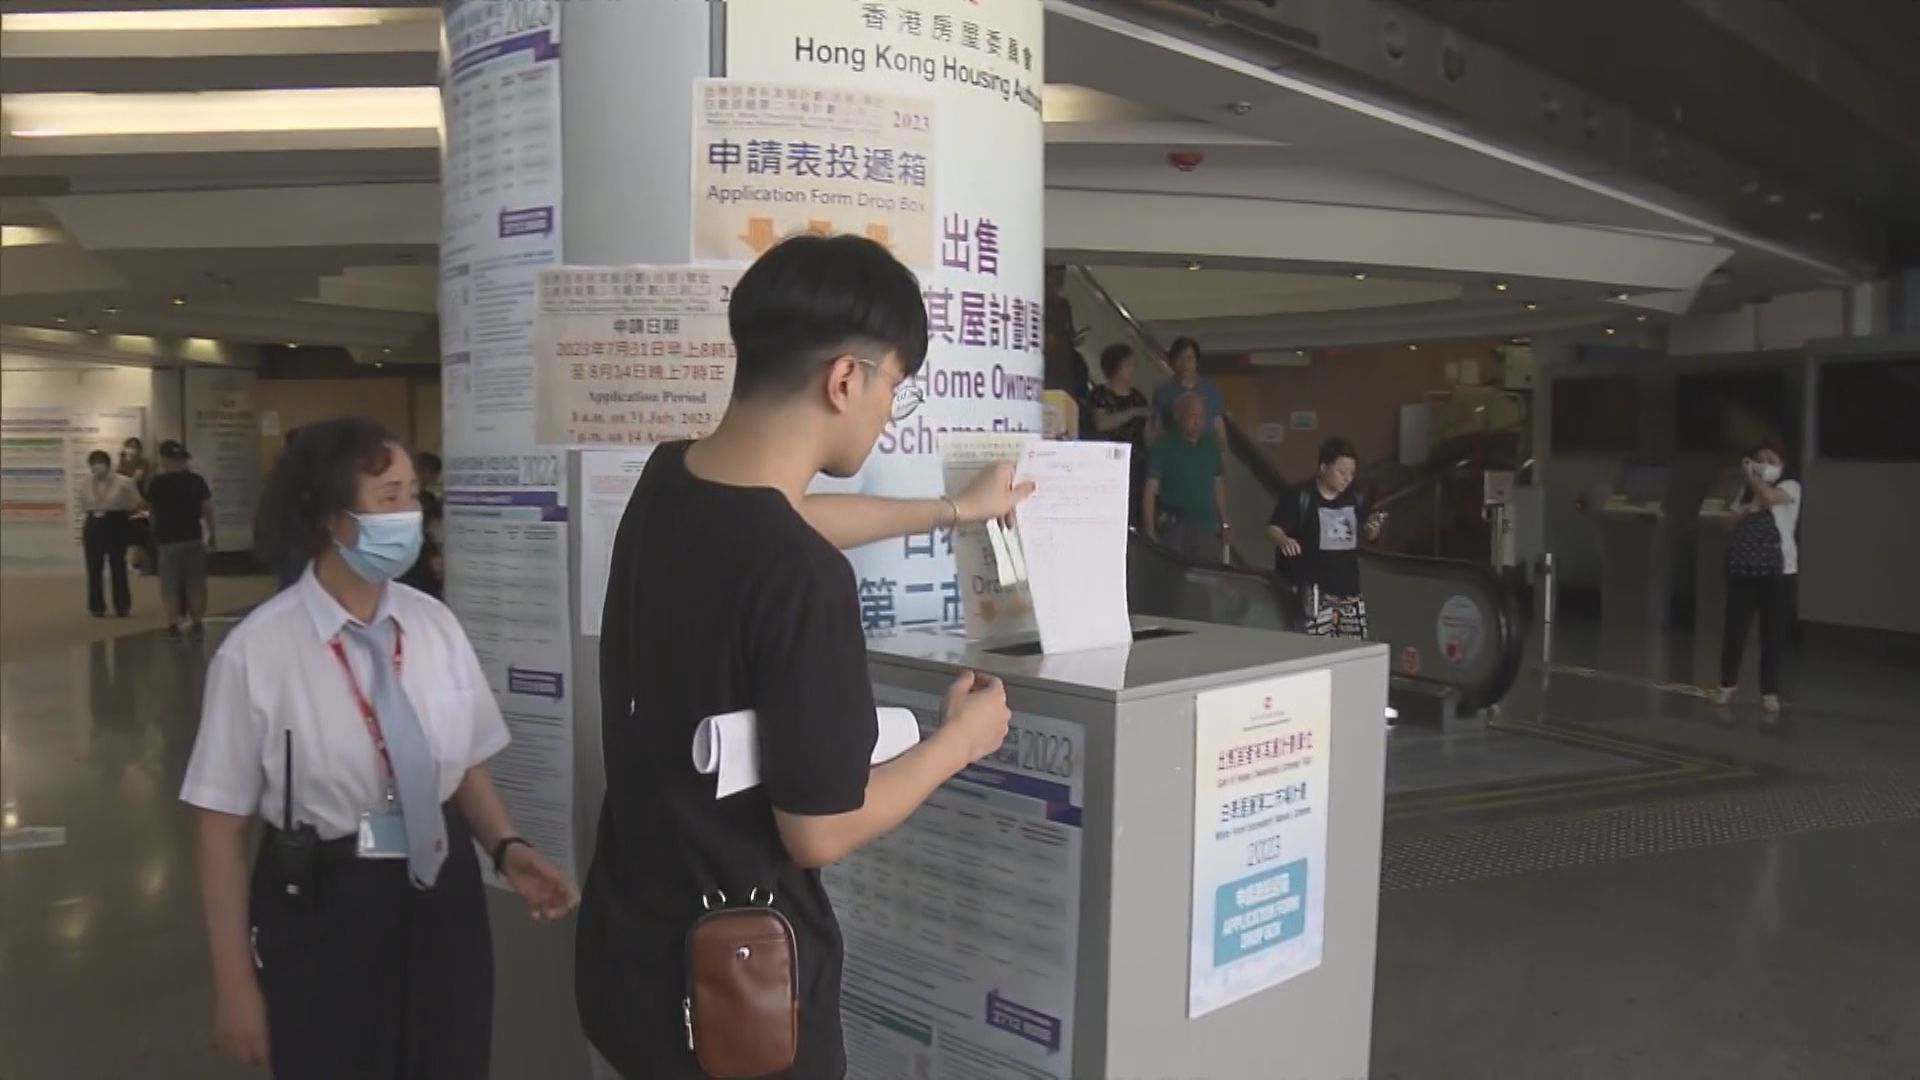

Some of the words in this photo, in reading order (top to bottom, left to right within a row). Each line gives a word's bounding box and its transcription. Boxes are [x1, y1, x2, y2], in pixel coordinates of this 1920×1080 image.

[795, 36, 866, 72] Hong
[875, 44, 936, 82] Kong
[943, 55, 1012, 102] Housing
[708, 139, 927, 187] 申請表投遞箱
[707, 185, 805, 205] Application
[811, 188, 853, 206] Form
[858, 192, 894, 211] Drop
[899, 196, 925, 212] Box
[942, 213, 999, 276] 出售
[911, 359, 985, 399] Home
